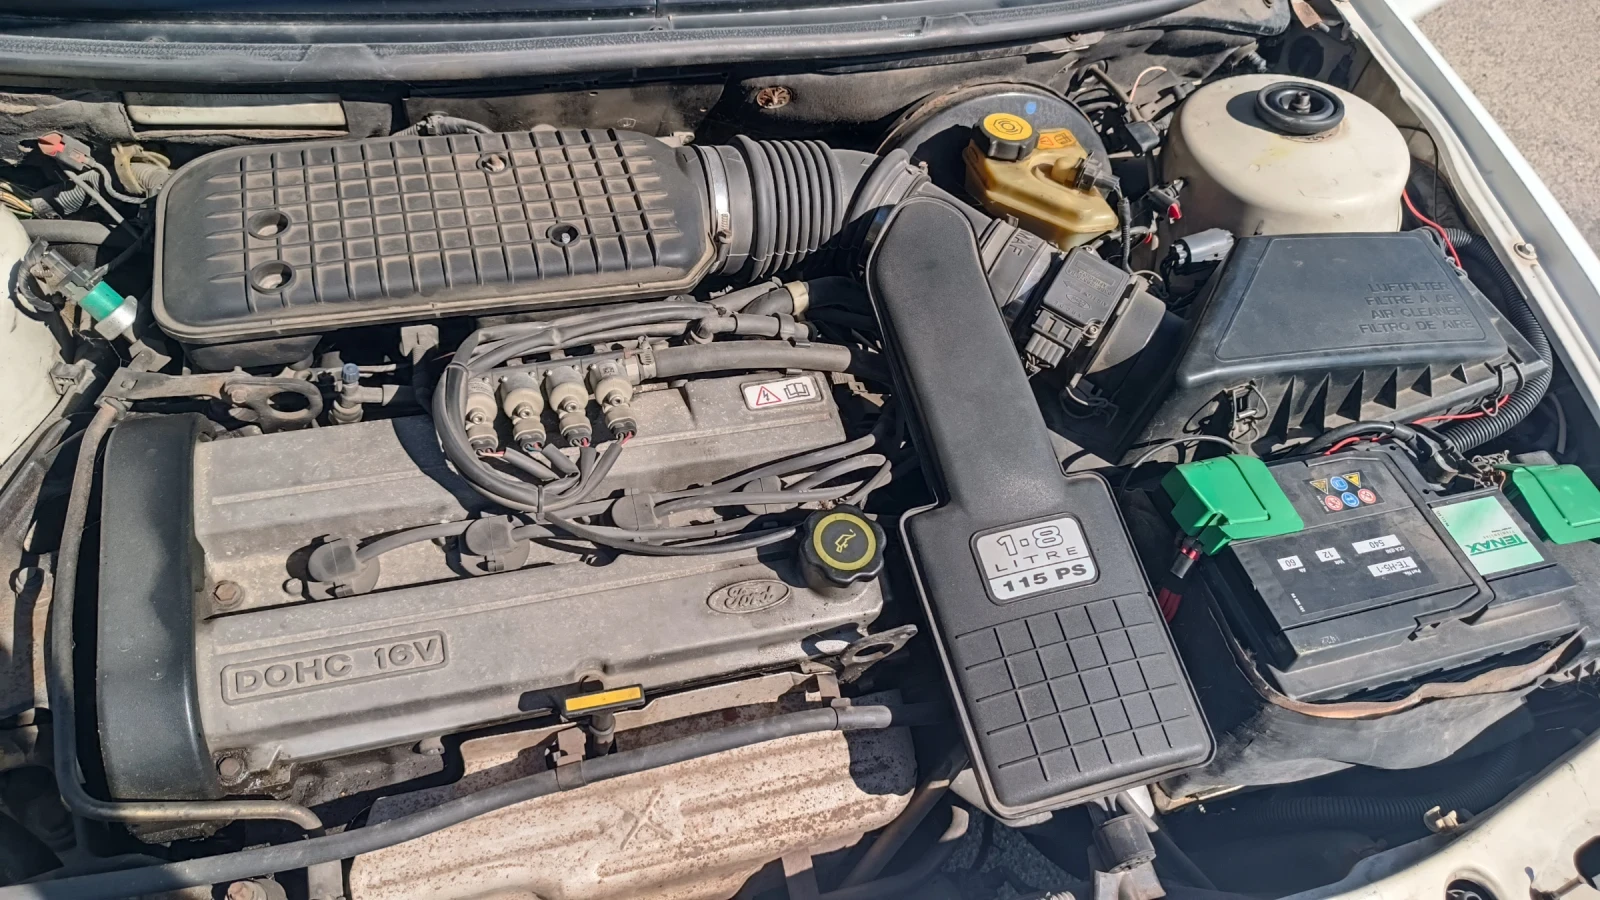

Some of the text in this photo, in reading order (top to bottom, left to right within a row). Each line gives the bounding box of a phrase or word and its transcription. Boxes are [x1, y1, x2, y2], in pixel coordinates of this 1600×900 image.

[1368, 281, 1450, 292] LUFTFILTER
[1364, 295, 1415, 306] FILTRE
[1435, 294, 1460, 304] AIR
[1371, 306, 1467, 319] AIR CLEANER
[1358, 319, 1475, 334] FILTRO DE AIRE
[1369, 540, 1385, 548] 540
[1465, 533, 1527, 556] TENAX
[995, 546, 1079, 572] LITRE
[1322, 551, 1334, 559] 12
[1285, 558, 1297, 567] 60
[1376, 560, 1411, 573] TE-H5-1
[1002, 564, 1087, 592] 115 PS
[723, 585, 776, 610] Ford
[235, 638, 438, 695] DOHC 16V
